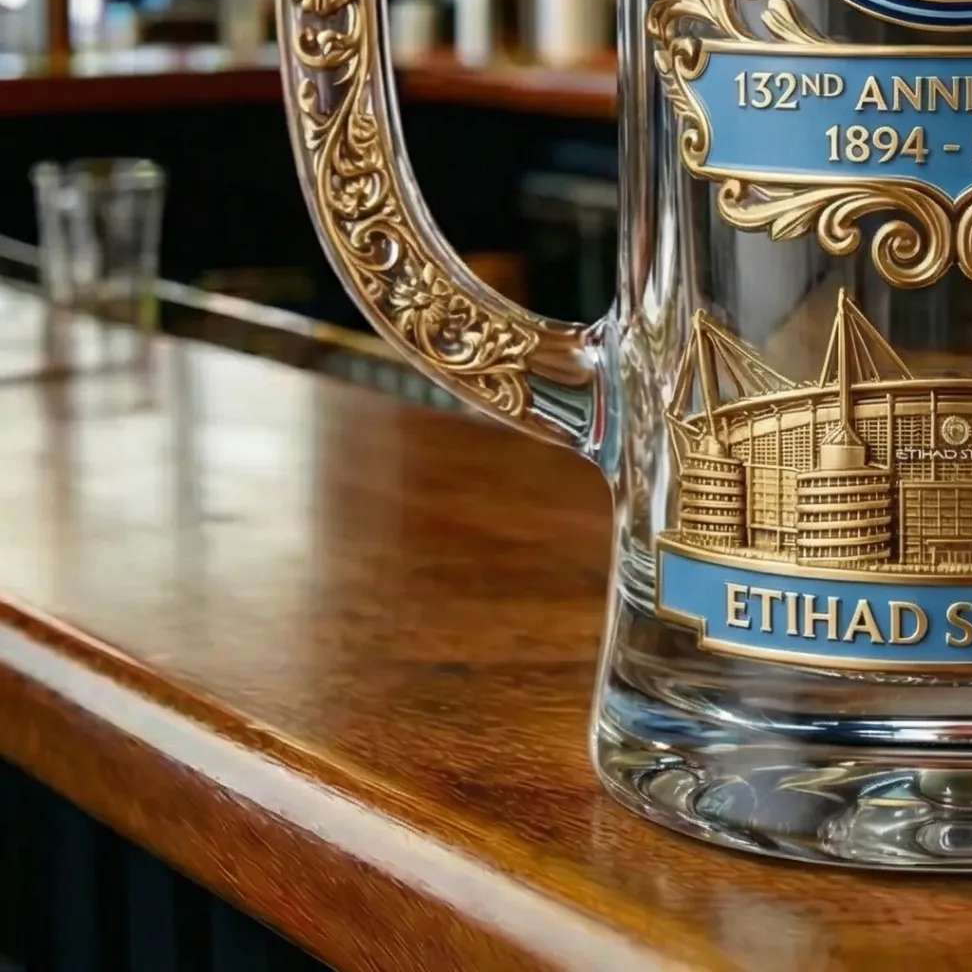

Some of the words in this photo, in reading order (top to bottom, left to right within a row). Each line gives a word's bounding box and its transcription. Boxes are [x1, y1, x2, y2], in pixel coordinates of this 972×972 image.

[734, 70, 844, 110] 132ND
[826, 125, 928, 164] 1894
[942, 142, 961, 153] -
[896, 447, 957, 461] ETIHAD
[724, 581, 928, 646] ETIHAD
